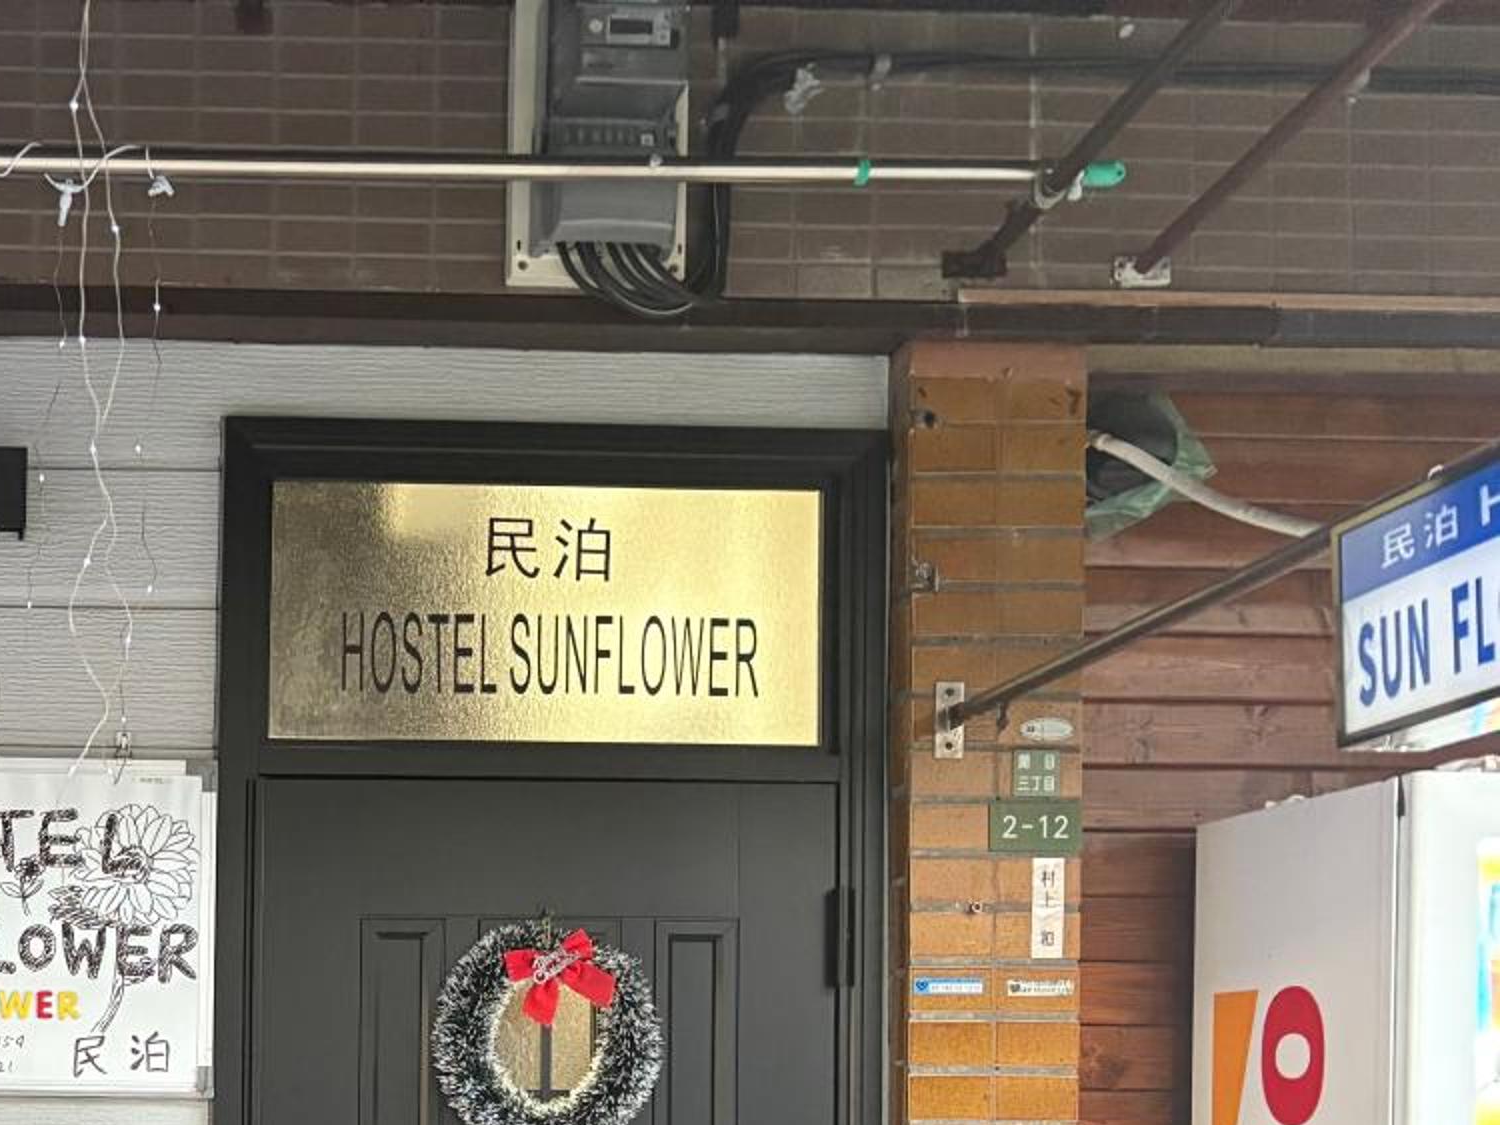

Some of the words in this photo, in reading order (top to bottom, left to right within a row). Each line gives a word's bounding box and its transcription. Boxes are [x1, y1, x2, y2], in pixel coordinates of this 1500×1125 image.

[484, 516, 613, 582] 民泊
[1381, 504, 1458, 569] 民泊
[340, 611, 497, 695] HOSTEL
[509, 613, 759, 698] SUNFLOWER
[1359, 598, 1431, 707] SUN
[1452, 576, 1500, 674] FL
[1001, 815, 1070, 840] 2-12
[73, 1031, 171, 1078] 民泊
